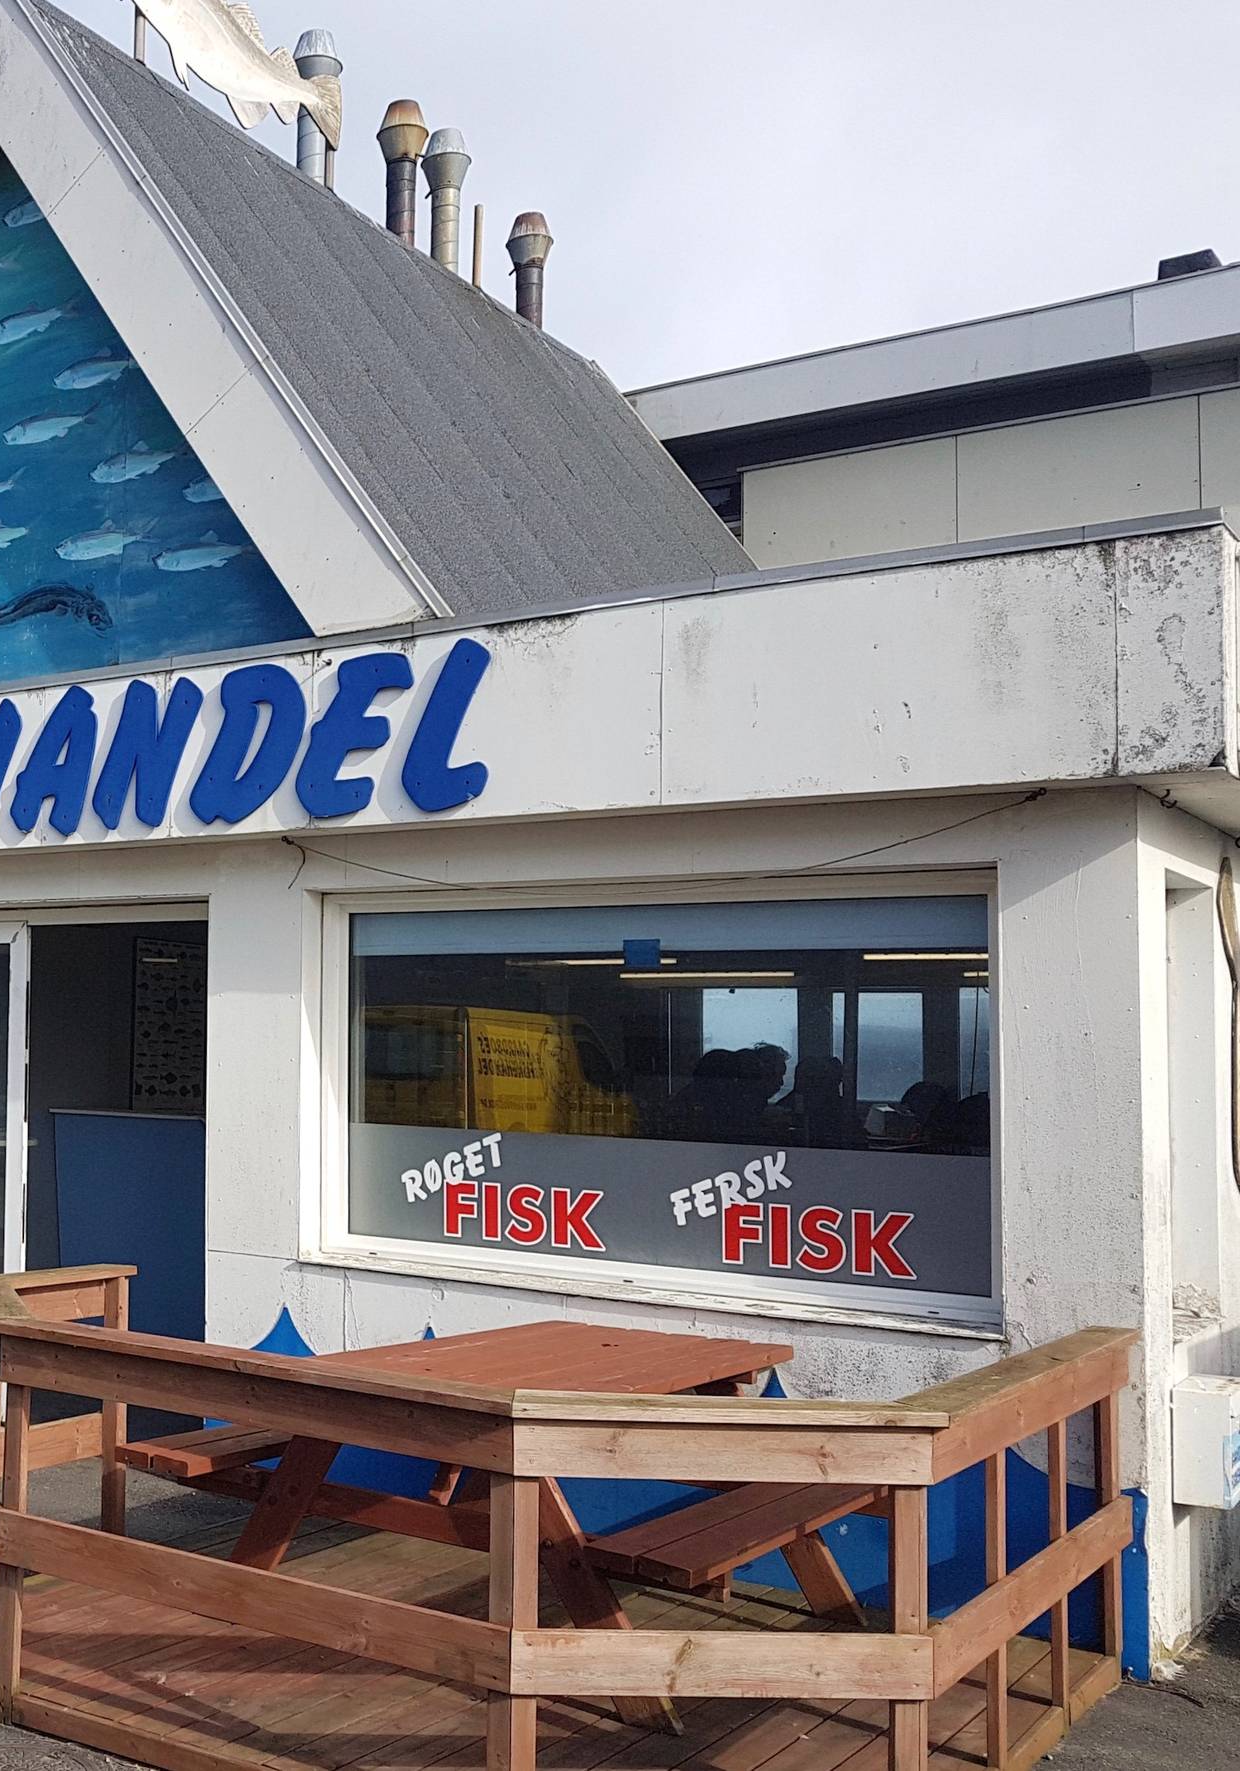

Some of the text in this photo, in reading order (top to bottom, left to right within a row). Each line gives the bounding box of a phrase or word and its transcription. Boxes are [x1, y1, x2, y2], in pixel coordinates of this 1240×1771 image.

[400, 1132, 502, 1203] RØGET
[670, 1151, 793, 1226] FERSK
[443, 1179, 607, 1252] FISK
[721, 1202, 918, 1280] FISK
